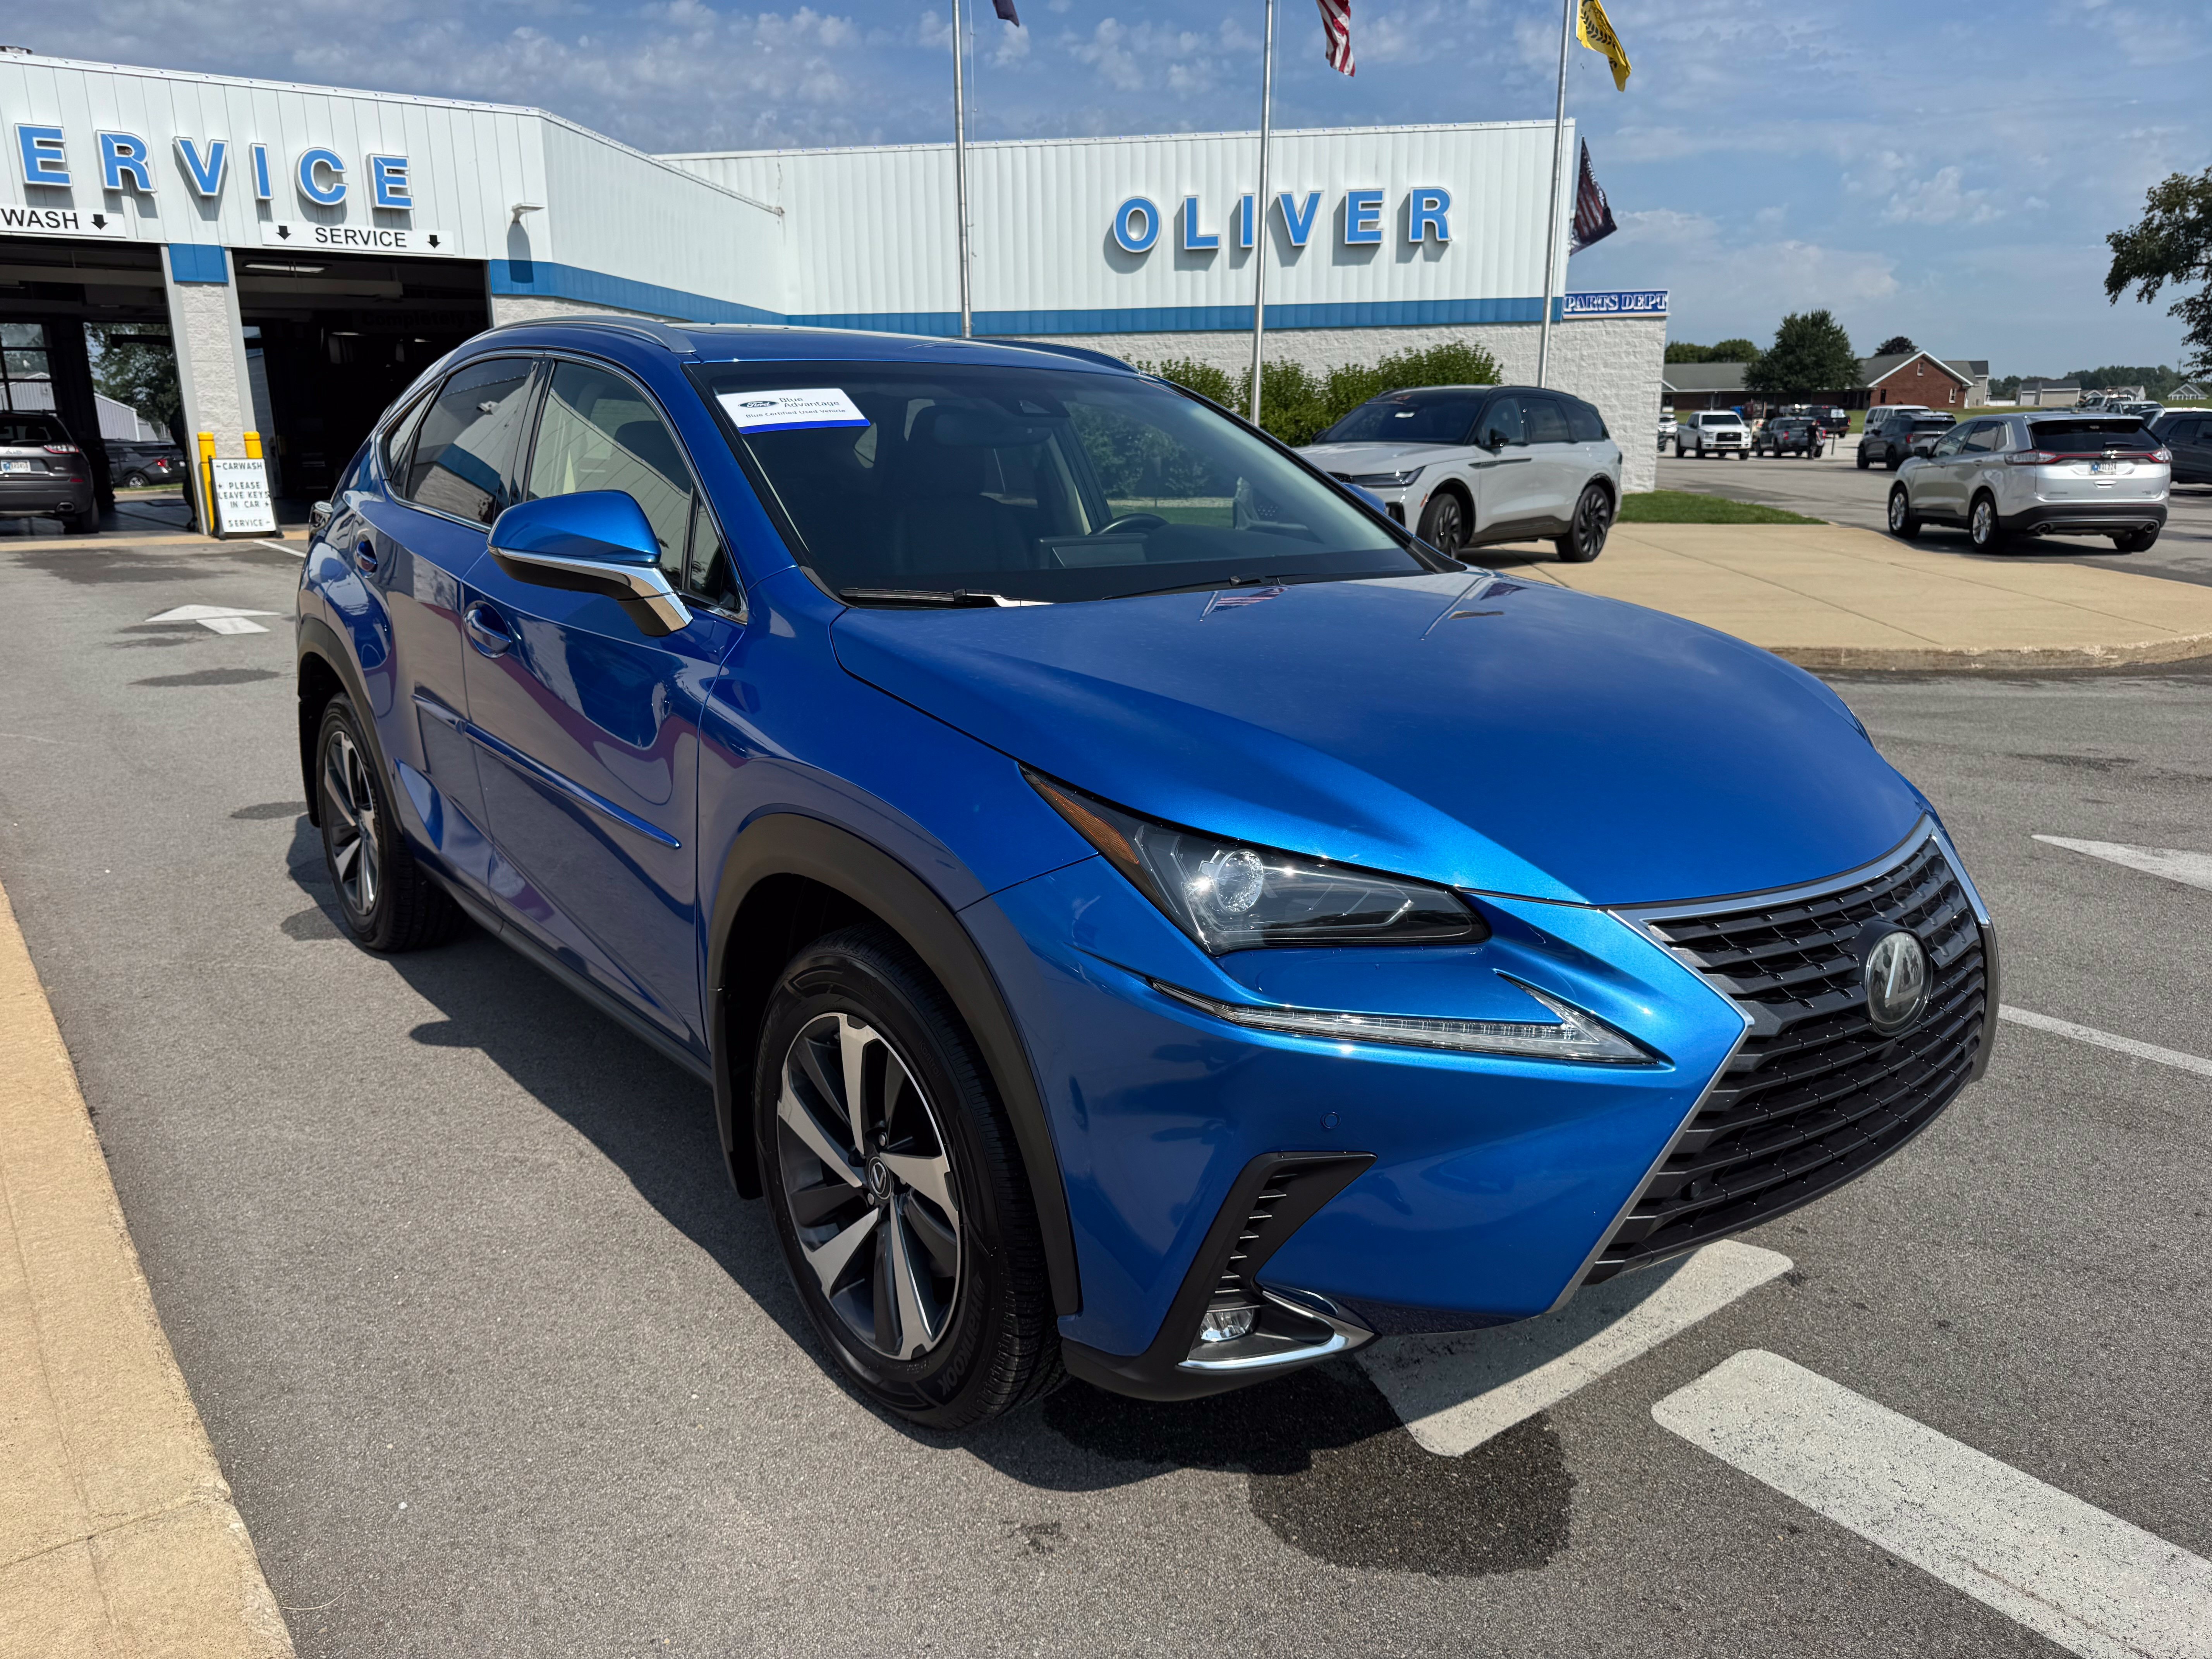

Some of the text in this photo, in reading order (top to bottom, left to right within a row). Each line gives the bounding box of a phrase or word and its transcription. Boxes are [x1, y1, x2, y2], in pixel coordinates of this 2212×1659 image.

[0, 208, 79, 229] WASH
[1113, 186, 1452, 253] OLIVER
[315, 227, 407, 247] SERVICE
[1563, 294, 1667, 312] PARTS DEPT
[218, 491, 270, 500] LEAVE KEYS
